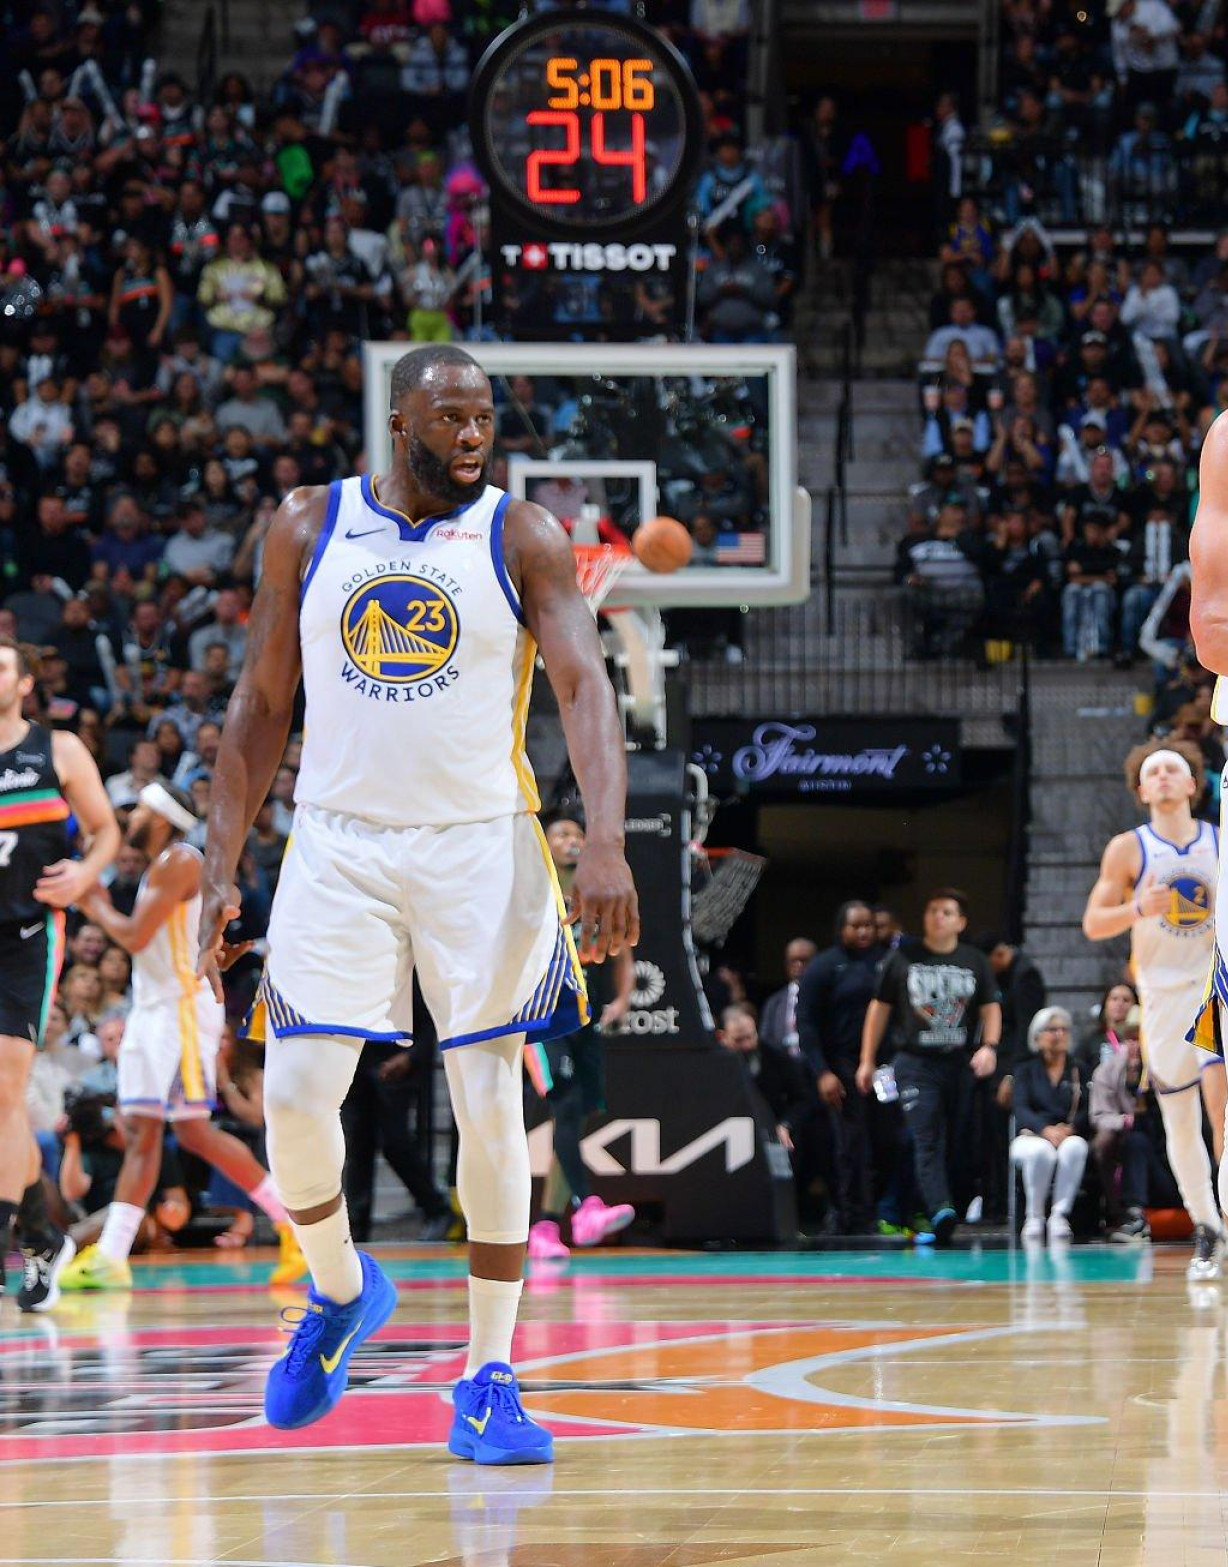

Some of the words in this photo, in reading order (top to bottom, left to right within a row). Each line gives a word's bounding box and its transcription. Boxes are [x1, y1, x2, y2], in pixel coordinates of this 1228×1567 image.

[547, 58, 654, 110] 5:06
[526, 111, 646, 204] 24
[549, 243, 676, 271] TISSOT
[436, 527, 483, 540] Rakuten
[342, 561, 411, 592] GOLDEN
[420, 564, 462, 596] STATE
[406, 599, 446, 632] 23
[341, 661, 460, 702] WARRIORS
[732, 721, 908, 783] Fairmont
